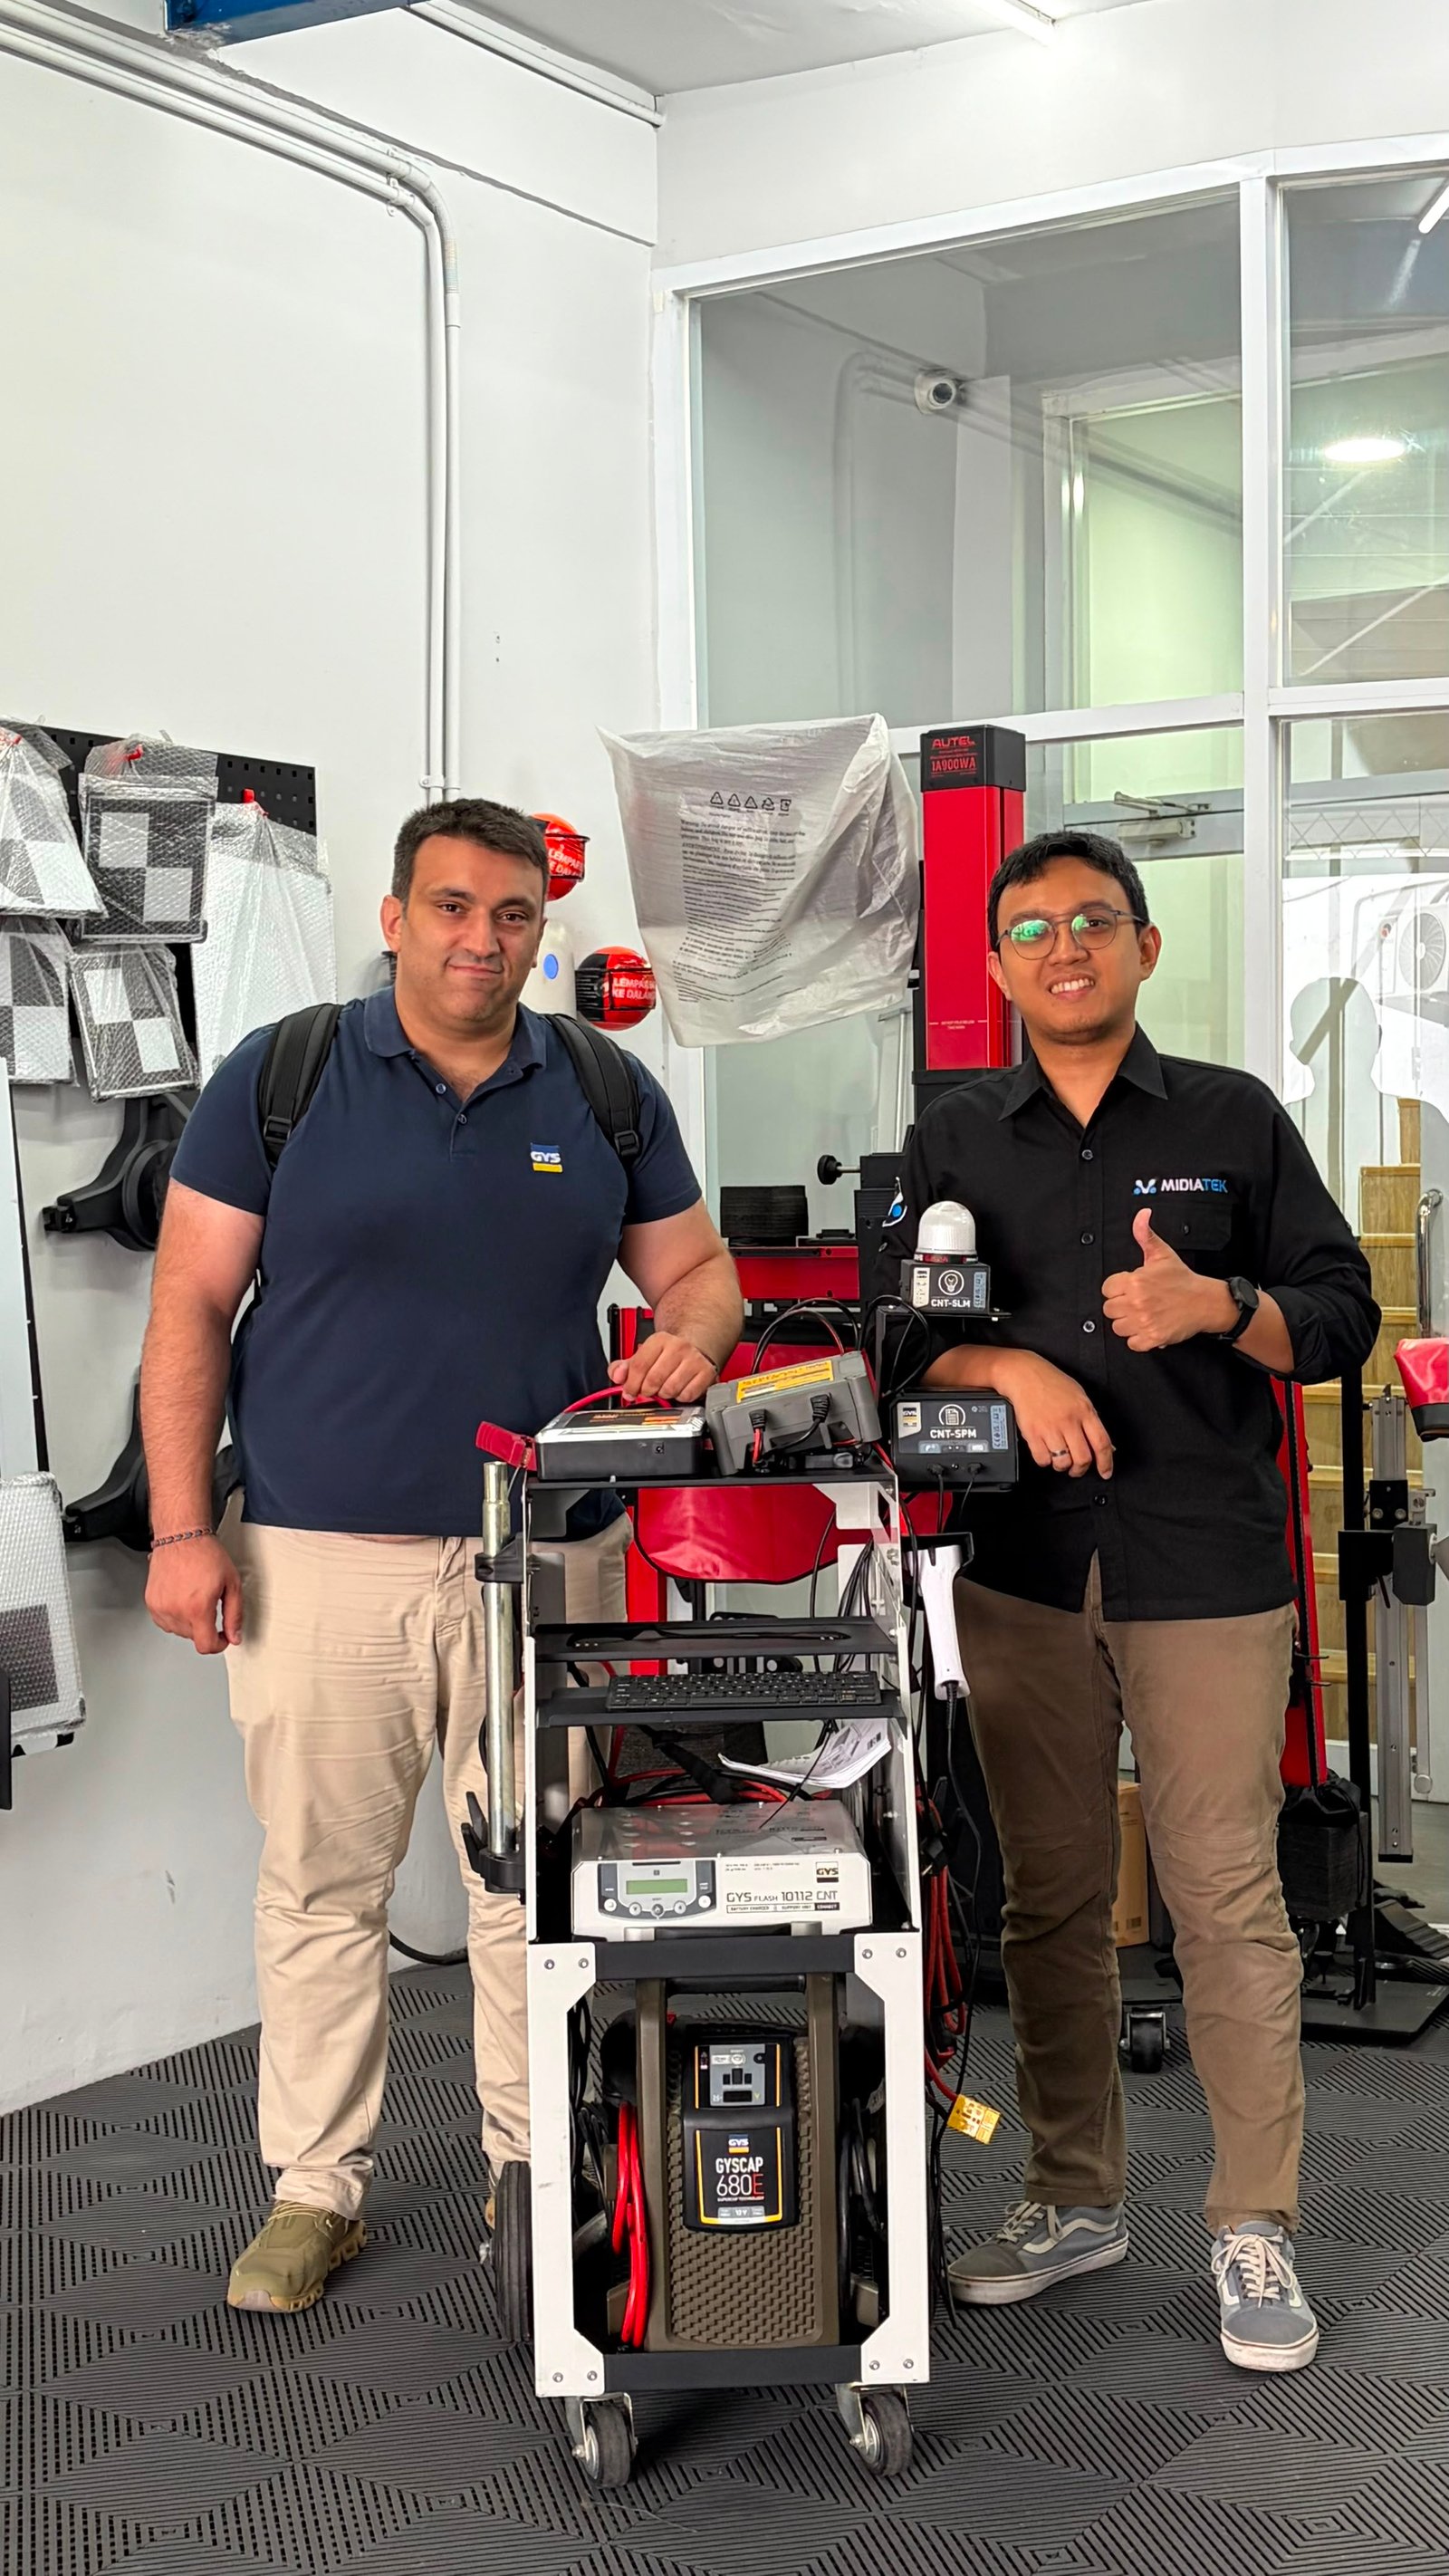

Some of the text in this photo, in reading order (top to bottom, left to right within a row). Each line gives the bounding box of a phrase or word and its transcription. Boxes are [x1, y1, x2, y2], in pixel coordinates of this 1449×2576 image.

[932, 735, 974, 748] AUTEL
[931, 756, 976, 772] IA900WA
[531, 1151, 561, 1164] GYS
[1161, 1177, 1228, 1193] MIDIATEK
[931, 1299, 971, 1308] CNT-SLM
[929, 1428, 977, 1439] CNT-SPM
[816, 1868, 839, 1876] GYS
[726, 1891, 752, 1903] GYS
[816, 1889, 838, 1900] CNT
[728, 2139, 749, 2147] GYS
[715, 2157, 763, 2174] GYSCAP
[716, 2173, 764, 2196] 680E
